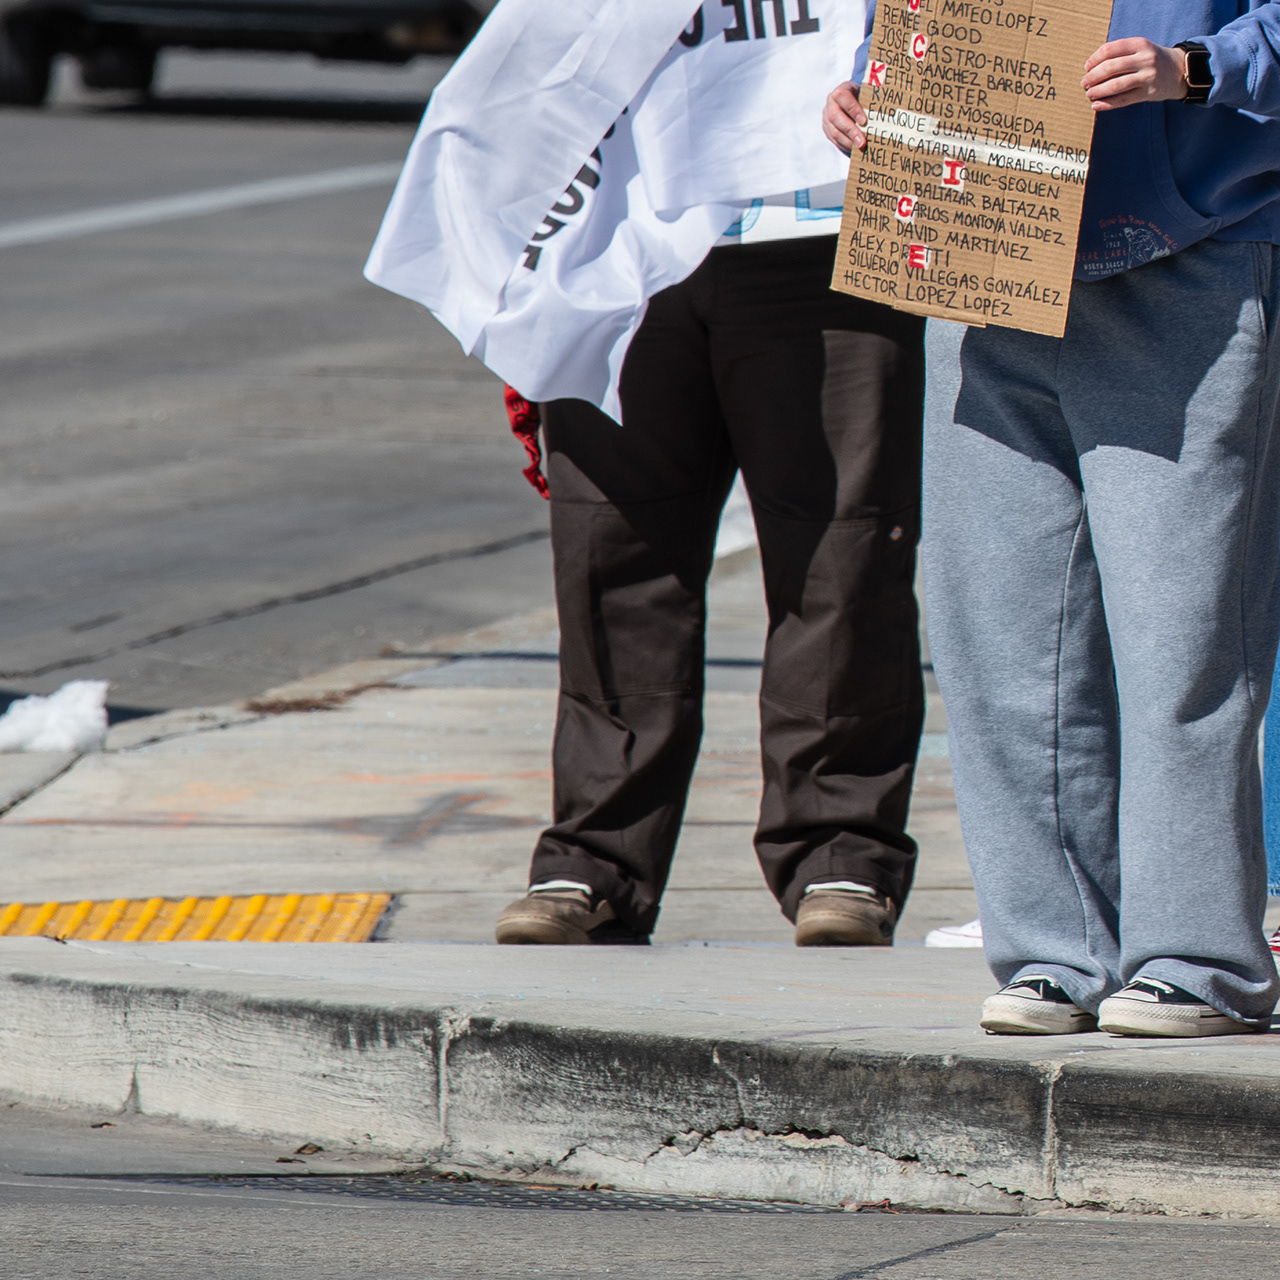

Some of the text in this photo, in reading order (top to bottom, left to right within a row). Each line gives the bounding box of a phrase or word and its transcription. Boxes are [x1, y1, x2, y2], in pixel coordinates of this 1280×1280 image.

[883, 4, 982, 44] RENEE GOOD
[942, 0, 993, 25] MATEO
[996, 12, 1048, 37] LOPEZ
[880, 25, 1053, 81] JOSE CASTRO-RIVERA
[867, 61, 989, 107] KEITH PORTER
[916, 56, 981, 87] SANCHEZ
[986, 74, 1057, 101] BARBOZA
[867, 102, 1088, 164] ENRIQUE JUAN TIZOL MACARIO
[872, 85, 1045, 137] RYAN LOUIS MOSQUEDA
[866, 126, 1086, 186] ELENA CATARINA MORALES-CHAN
[856, 187, 898, 212] ROBERTO
[898, 196, 949, 223] CARLOS
[953, 211, 1006, 235] MONTOYA
[1009, 219, 1067, 246] VALDEZ
[858, 167, 1062, 223] BARTOLO BALTAZAR BALTAZAR
[850, 231, 950, 268] ALEX PRETTI
[856, 206, 890, 232] YAHIR
[896, 219, 938, 243] DAVID
[945, 232, 1033, 262] MARTINEZ
[844, 270, 1013, 318] HECTOR LOPEZ LOPEZ
[849, 248, 899, 276] SILVERIO
[905, 265, 979, 292] VILLEGAS
